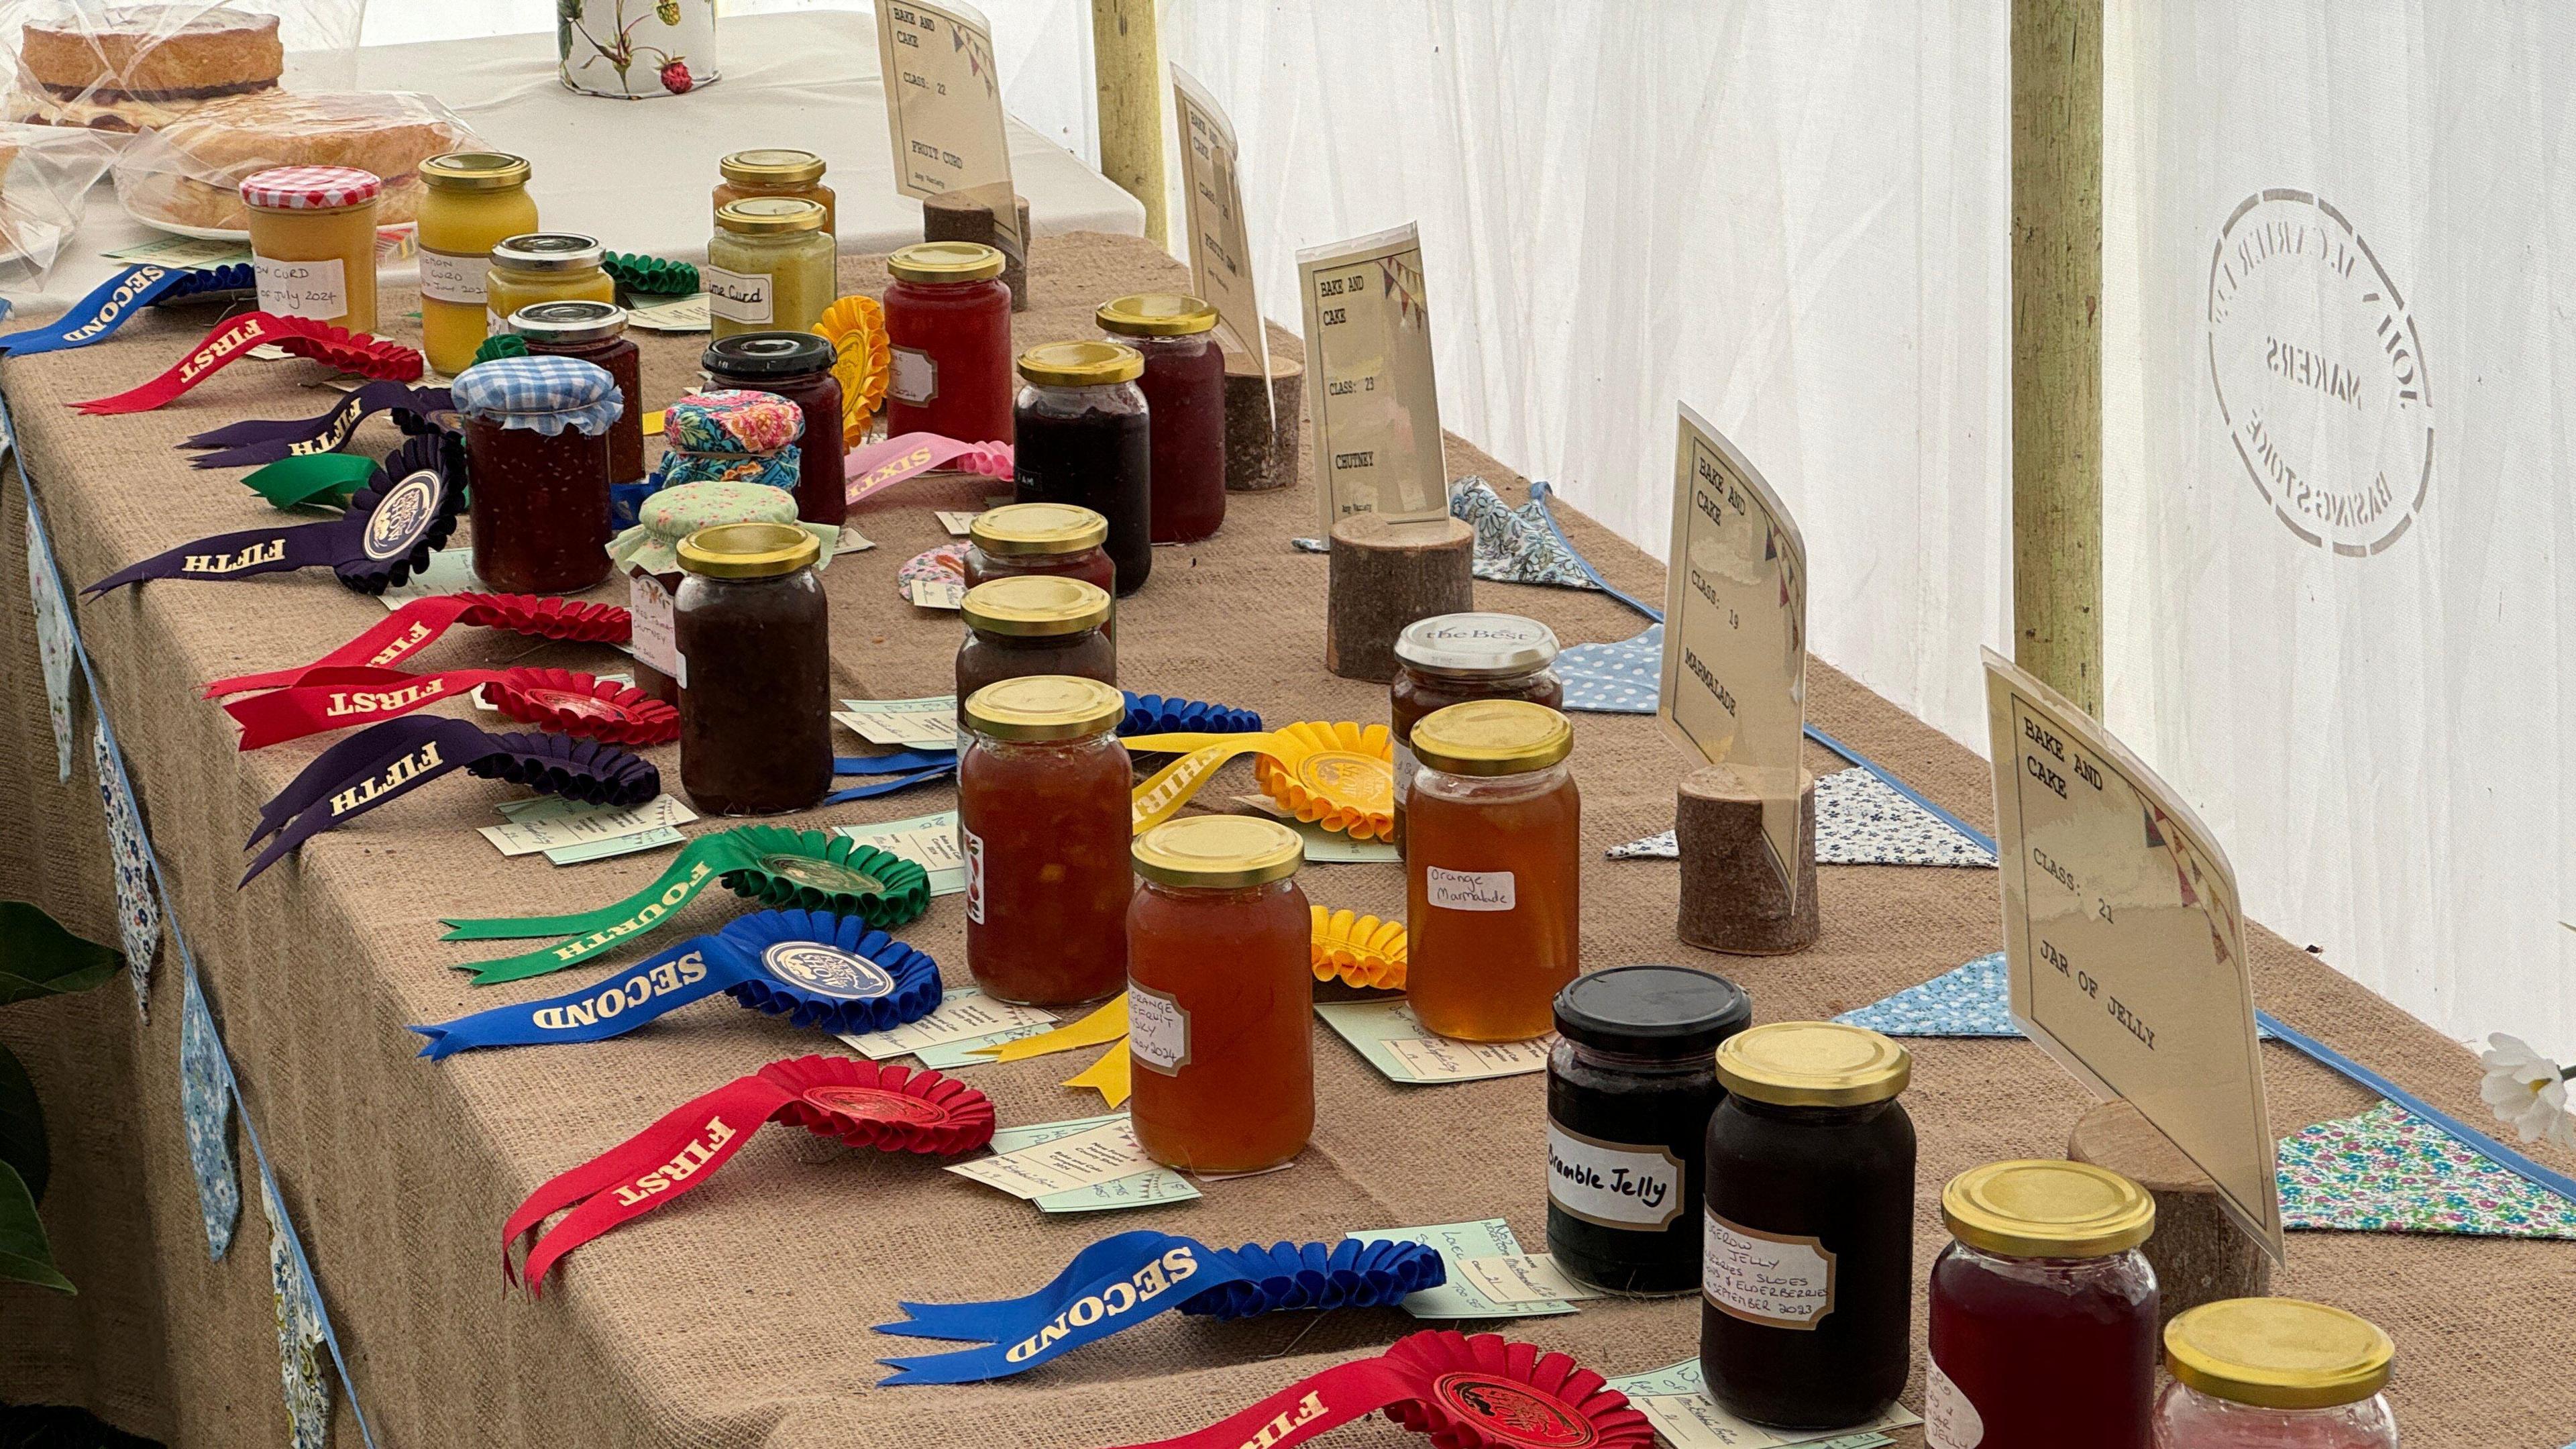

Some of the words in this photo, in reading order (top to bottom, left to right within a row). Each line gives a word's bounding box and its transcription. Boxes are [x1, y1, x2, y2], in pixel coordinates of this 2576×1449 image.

[894, 8, 915, 25] BAKE
[920, 15, 934, 32] AND
[897, 31, 918, 48] CAKE
[904, 72, 929, 89] CLASS:
[937, 83, 946, 95] 22
[912, 140, 938, 160] FRUIT
[943, 152, 963, 169] CURD
[274, 268, 309, 279] CURD
[1320, 279, 1344, 297] BAKE
[1348, 275, 1364, 292] AND
[62, 266, 165, 342] SECOND
[274, 289, 300, 309] July
[305, 291, 337, 305] 2024
[729, 284, 762, 303] Curd
[1324, 308, 1346, 326] CAKE
[178, 319, 266, 383] FIRST
[1330, 381, 1357, 396] CLASS:
[1364, 376, 1375, 390] 23
[288, 397, 362, 456] FIFTH
[1336, 451, 1374, 470] CHUTNEY
[1699, 457, 1724, 494] BAKE
[1727, 487, 1746, 517] AND
[388, 498, 405, 541] SHOW
[1696, 490, 1721, 526] CAKE
[182, 539, 286, 573] FIFTH
[1691, 569, 1720, 610] CLASS:
[1729, 609, 1739, 631] 19
[367, 621, 433, 667] FIR
[1427, 627, 1468, 639] the
[1472, 629, 1529, 640] Best
[327, 678, 443, 716] FIRST
[1685, 647, 1735, 718] MARMALADE
[2023, 717, 2065, 762] BAKE
[2074, 753, 2103, 792] AND
[330, 741, 443, 816] FIFTH
[2027, 756, 2068, 800] CAKE
[1432, 869, 1482, 892] Orange
[1438, 888, 1507, 904] Marmalade
[2033, 847, 2081, 897] CLASS:
[2098, 898, 2114, 924] 21
[553, 859, 711, 961] FOURTH
[798, 954, 848, 988] SHOW
[533, 951, 707, 1029] SECOND
[2040, 940, 2070, 977] JAR
[2078, 969, 2098, 1000] OF
[2108, 997, 2155, 1050] JELLY
[1150, 1042, 1177, 1063] 2024
[612, 1116, 737, 1205] FIRST
[1548, 1143, 1604, 1189] Bramble
[1611, 1169, 1666, 1208] Jelly
[1727, 1249, 1779, 1269] JELLY
[1756, 1274, 1808, 1286] SLOES
[1006, 1245, 1197, 1362] SECOND
[1713, 1283, 1770, 1311] SEPTEMBER
[1779, 1303, 1812, 1315] 2023
